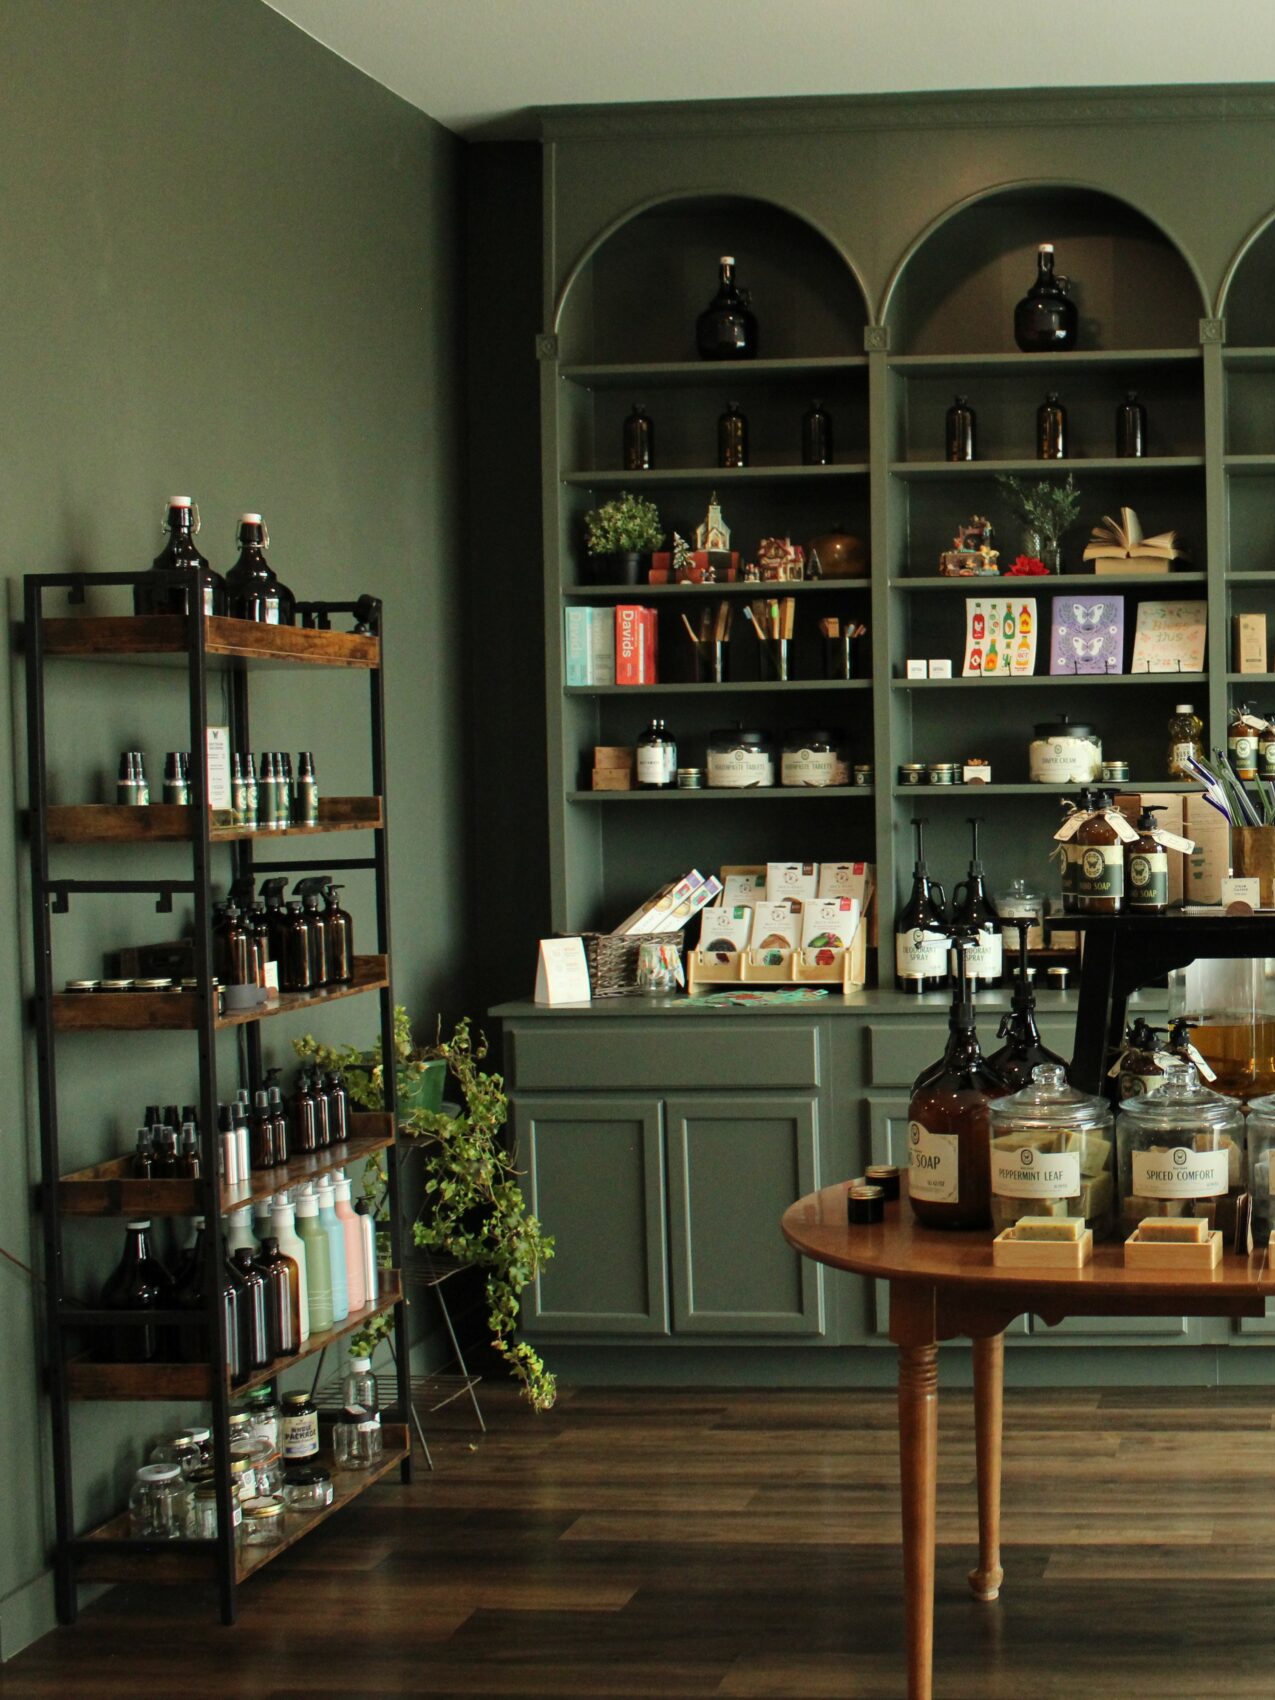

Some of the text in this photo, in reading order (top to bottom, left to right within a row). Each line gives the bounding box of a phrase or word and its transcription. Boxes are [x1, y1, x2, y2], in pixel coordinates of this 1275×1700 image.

[622, 610, 634, 657] Davids
[1094, 882, 1111, 890] SOAP
[910, 953, 929, 961] SPRAY
[915, 1155, 941, 1170] SOAP
[999, 1167, 1064, 1181] PEPPERMINT LEAF
[1146, 1169, 1214, 1181] SPICED COMFORT
